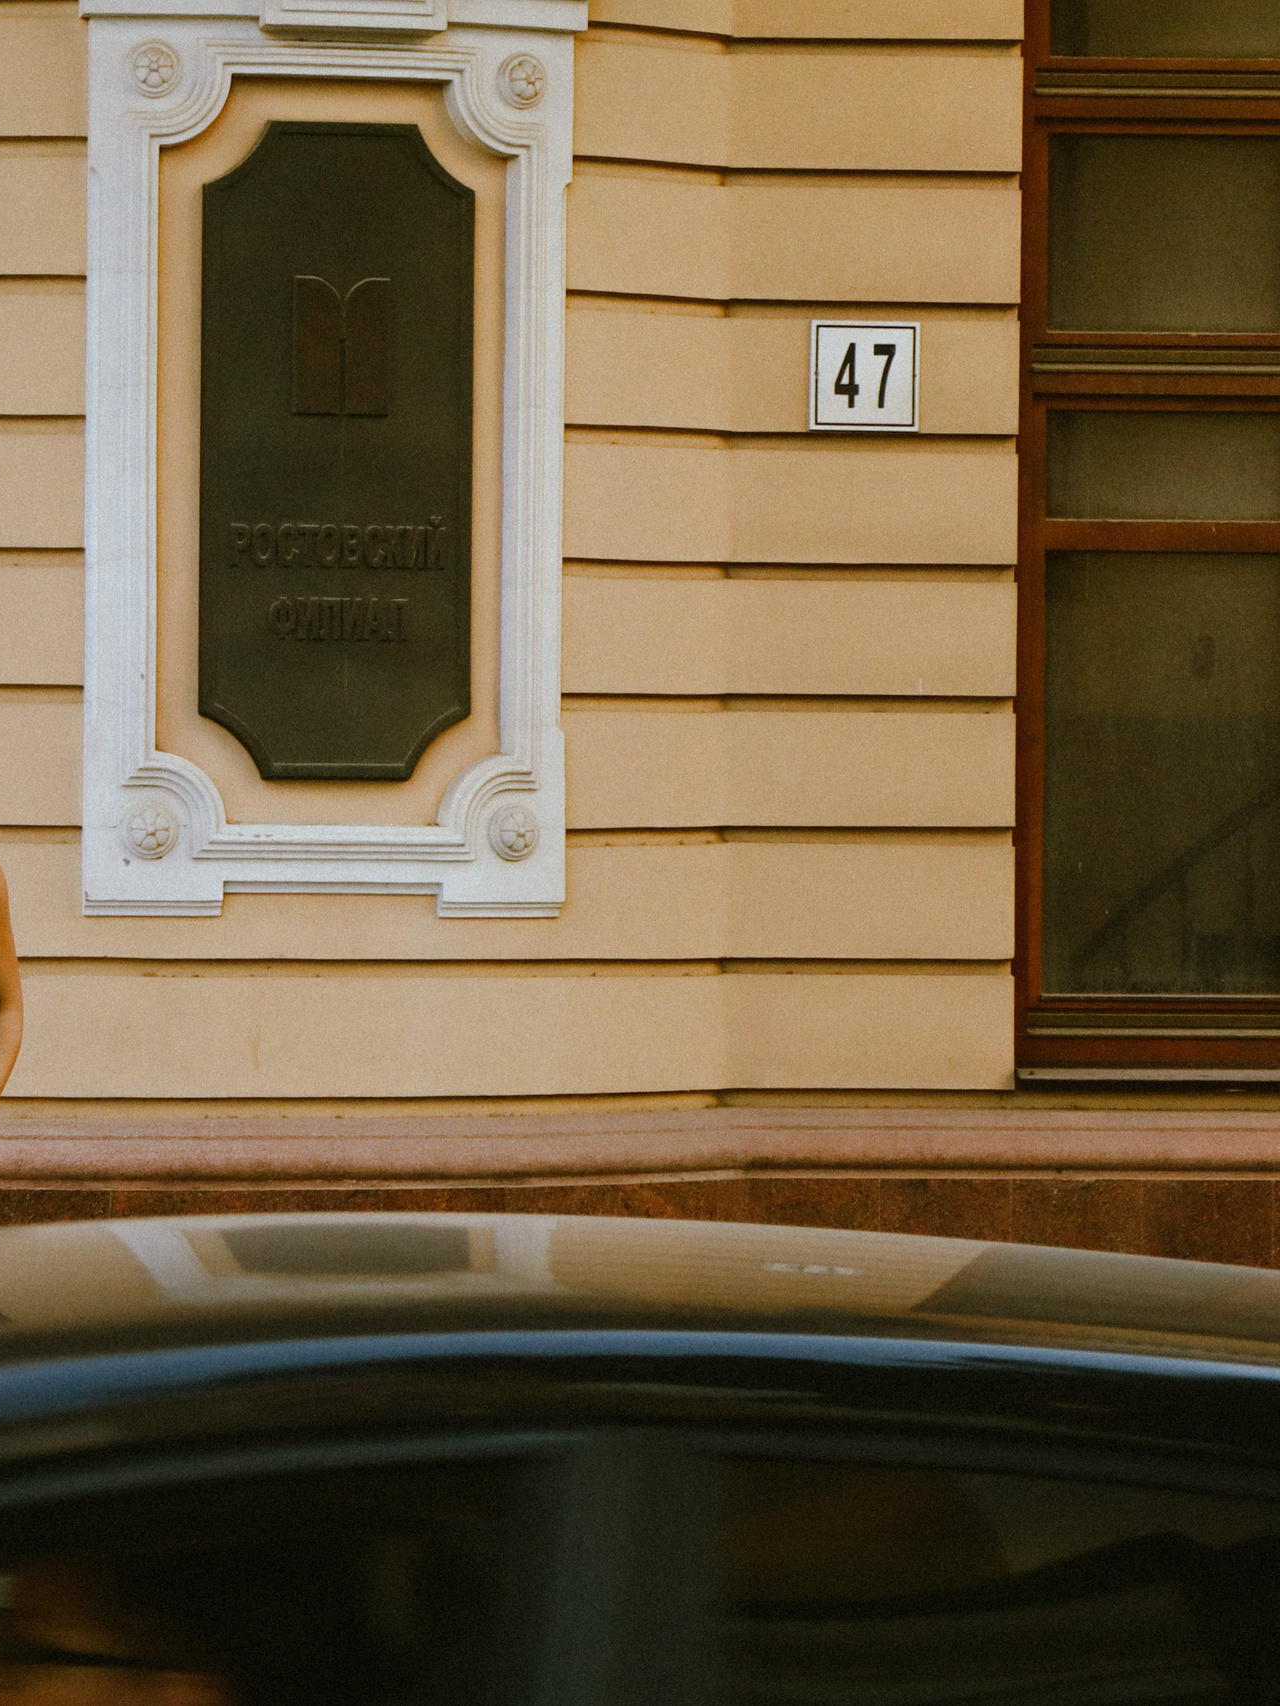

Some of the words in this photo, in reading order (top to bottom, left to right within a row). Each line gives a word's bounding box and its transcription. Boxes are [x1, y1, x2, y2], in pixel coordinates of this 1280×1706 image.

[834, 342, 896, 409] 47
[228, 515, 447, 571] РОСТОВСКИЙ
[270, 596, 410, 642] ФИЛИАЛ
